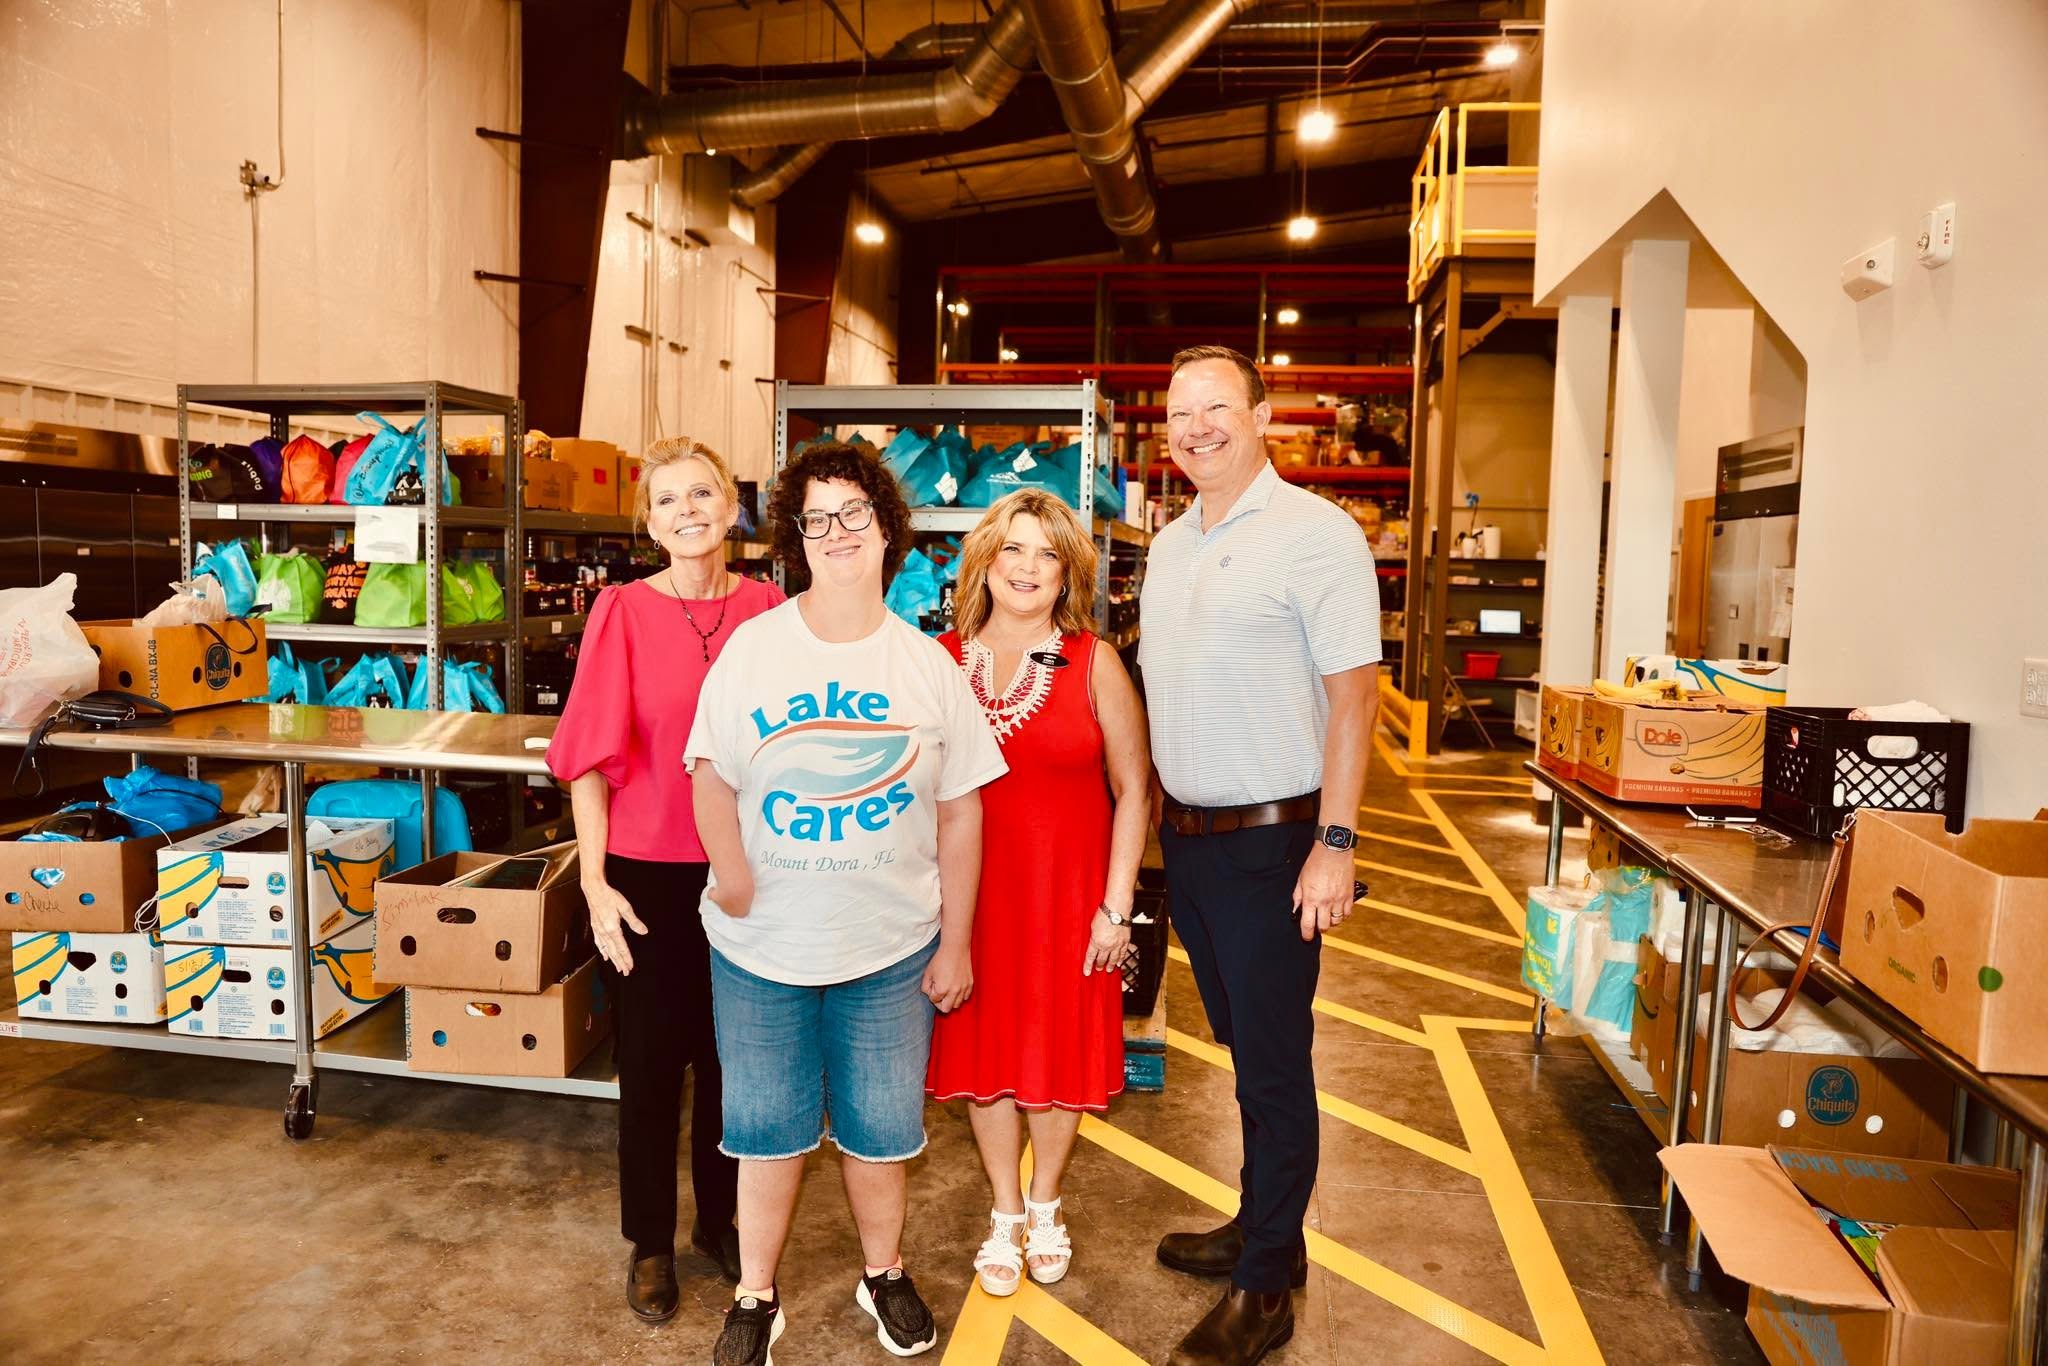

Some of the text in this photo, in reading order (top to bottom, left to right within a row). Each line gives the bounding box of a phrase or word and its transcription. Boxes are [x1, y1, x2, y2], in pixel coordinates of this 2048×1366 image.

[1943, 219, 1951, 245] FIRE
[750, 681, 890, 740] Lake
[1643, 727, 1683, 747] Dole
[1624, 783, 1752, 797] PREMIUM BANANAS PREMIUM BANANAS
[762, 781, 915, 842] Cares
[761, 850, 809, 871] Mount
[870, 848, 896, 870] FL
[1807, 1096, 1857, 1117] Chiquita
